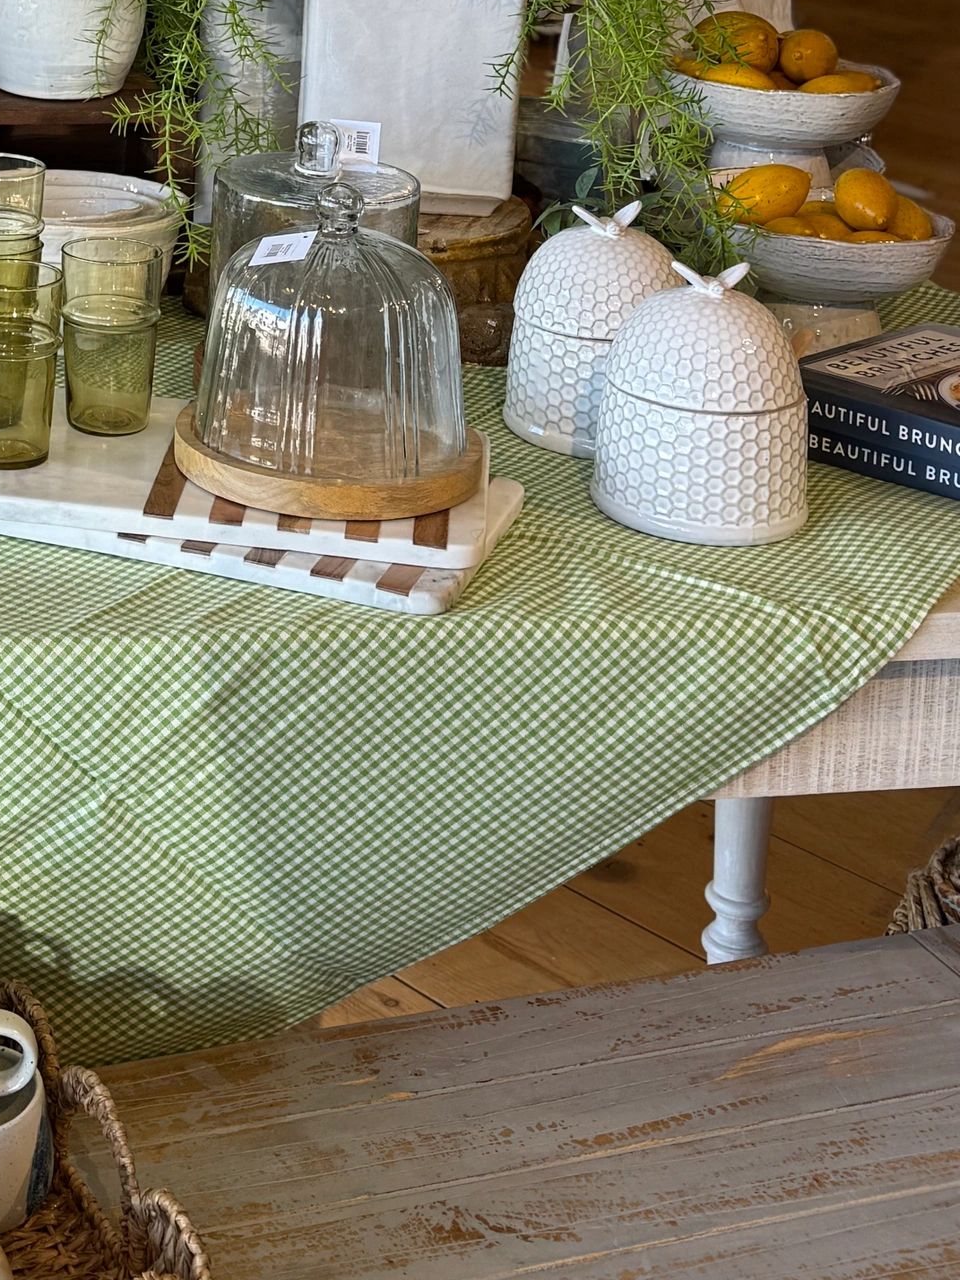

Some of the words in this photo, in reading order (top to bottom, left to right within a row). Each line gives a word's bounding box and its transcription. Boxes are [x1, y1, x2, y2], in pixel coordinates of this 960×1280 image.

[826, 336, 945, 371] BEAUTIFUL
[808, 400, 890, 436] AUTIFUL
[809, 433, 917, 476] BEAUTIFUL
